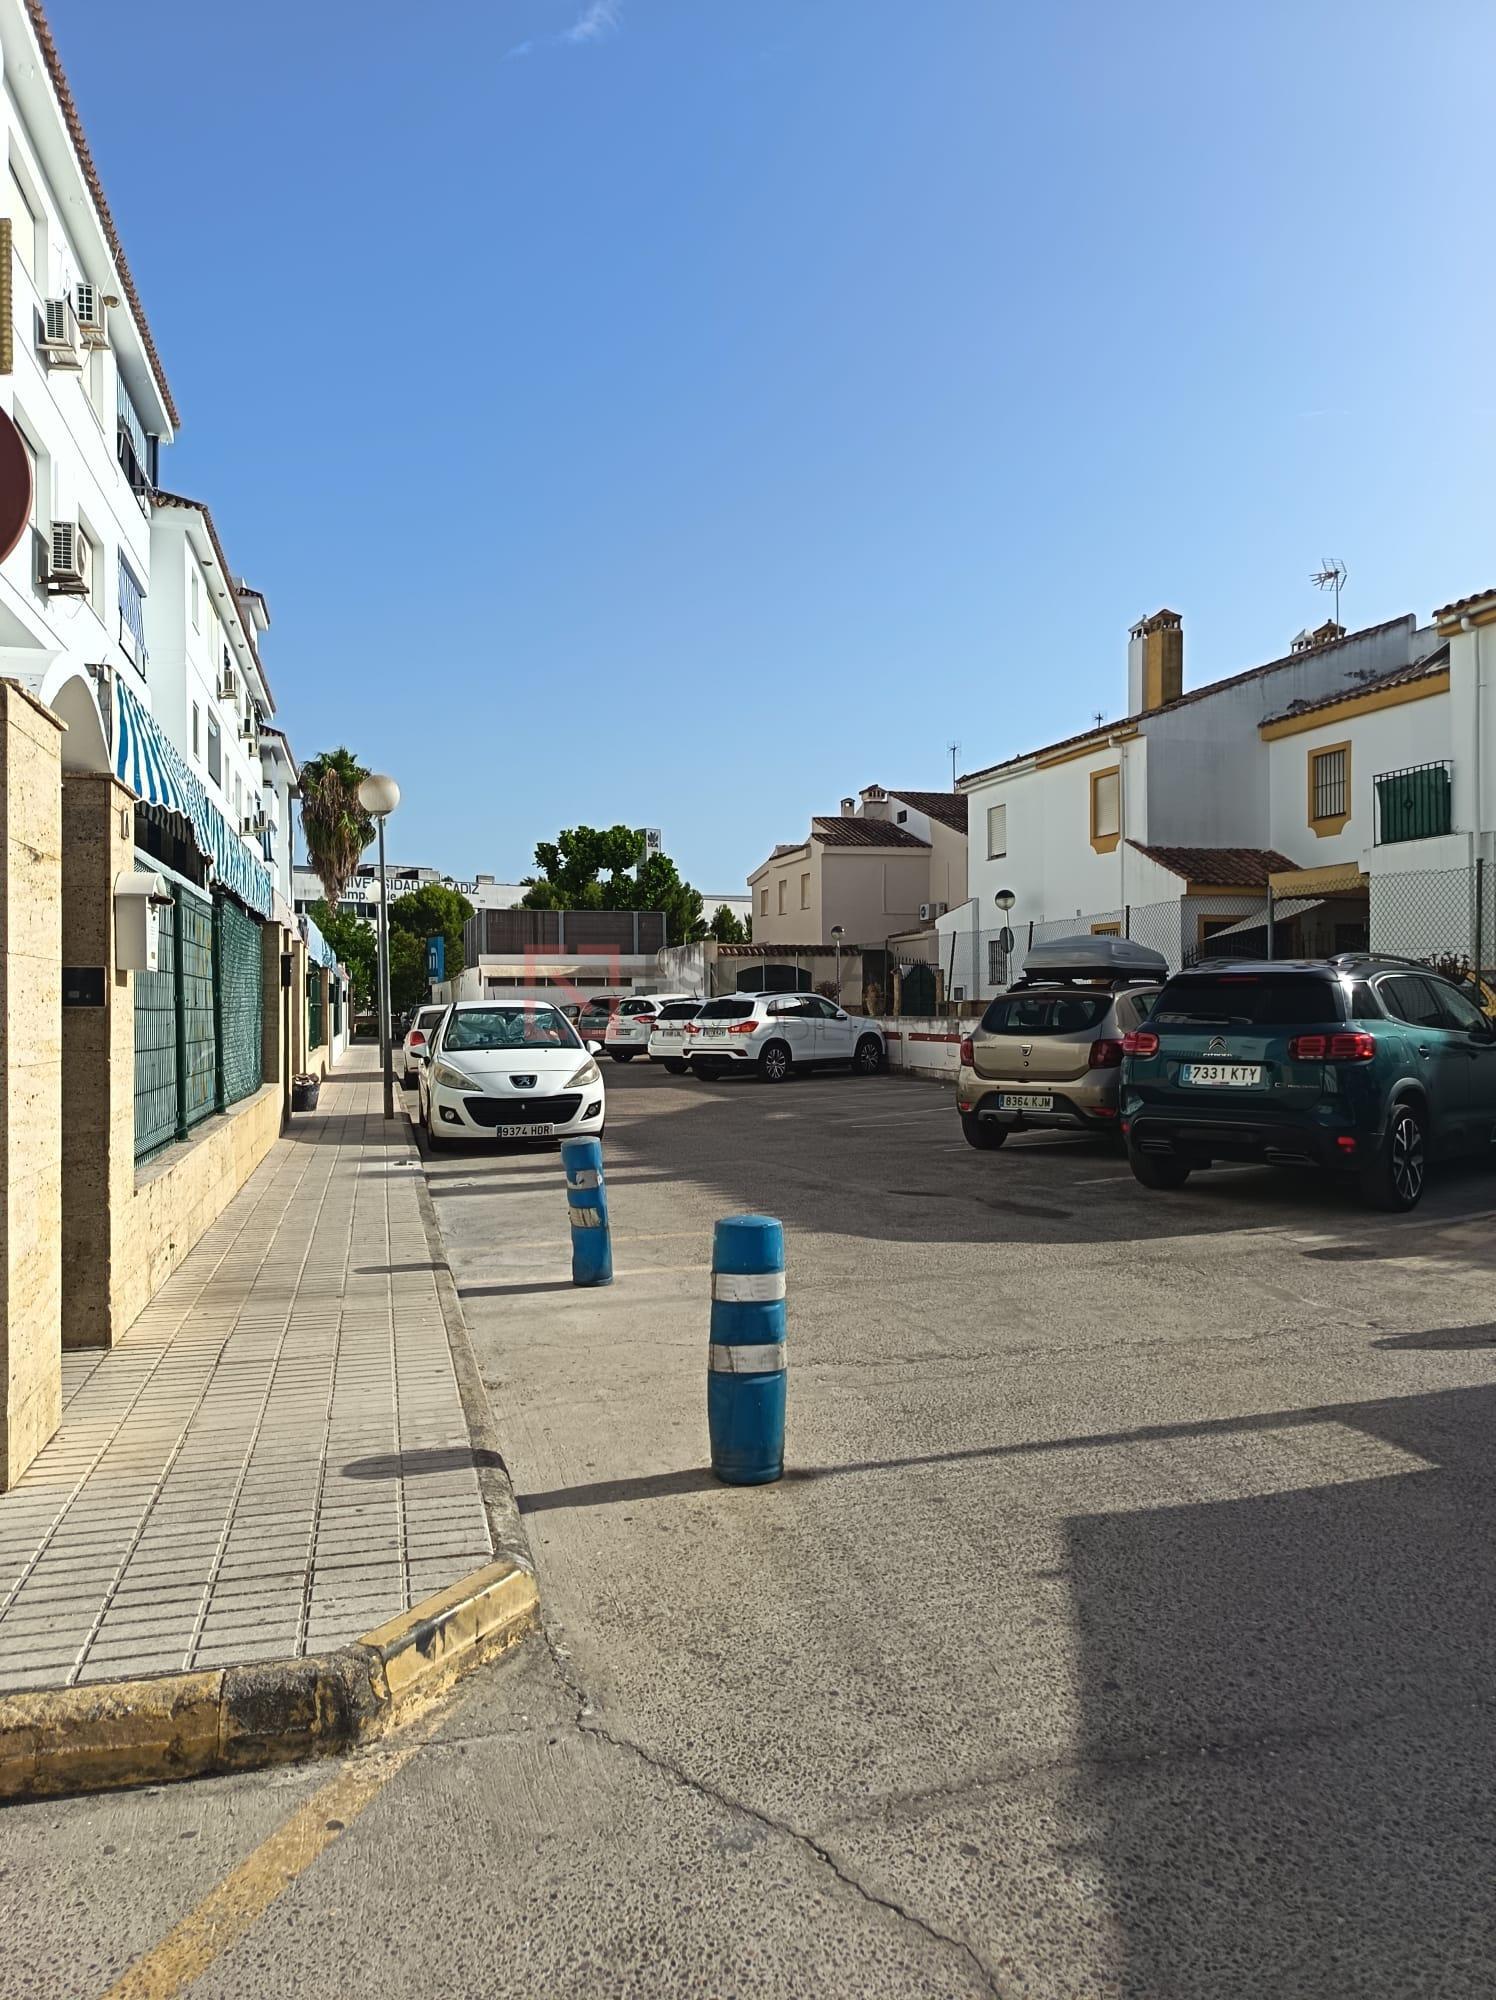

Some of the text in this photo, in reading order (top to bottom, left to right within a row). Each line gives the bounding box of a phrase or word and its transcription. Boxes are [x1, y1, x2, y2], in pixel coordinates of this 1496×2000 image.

[1193, 1066, 1257, 1081] 7331 KTY
[1005, 1096, 1029, 1106] 8364
[502, 1126, 528, 1136] 9374
